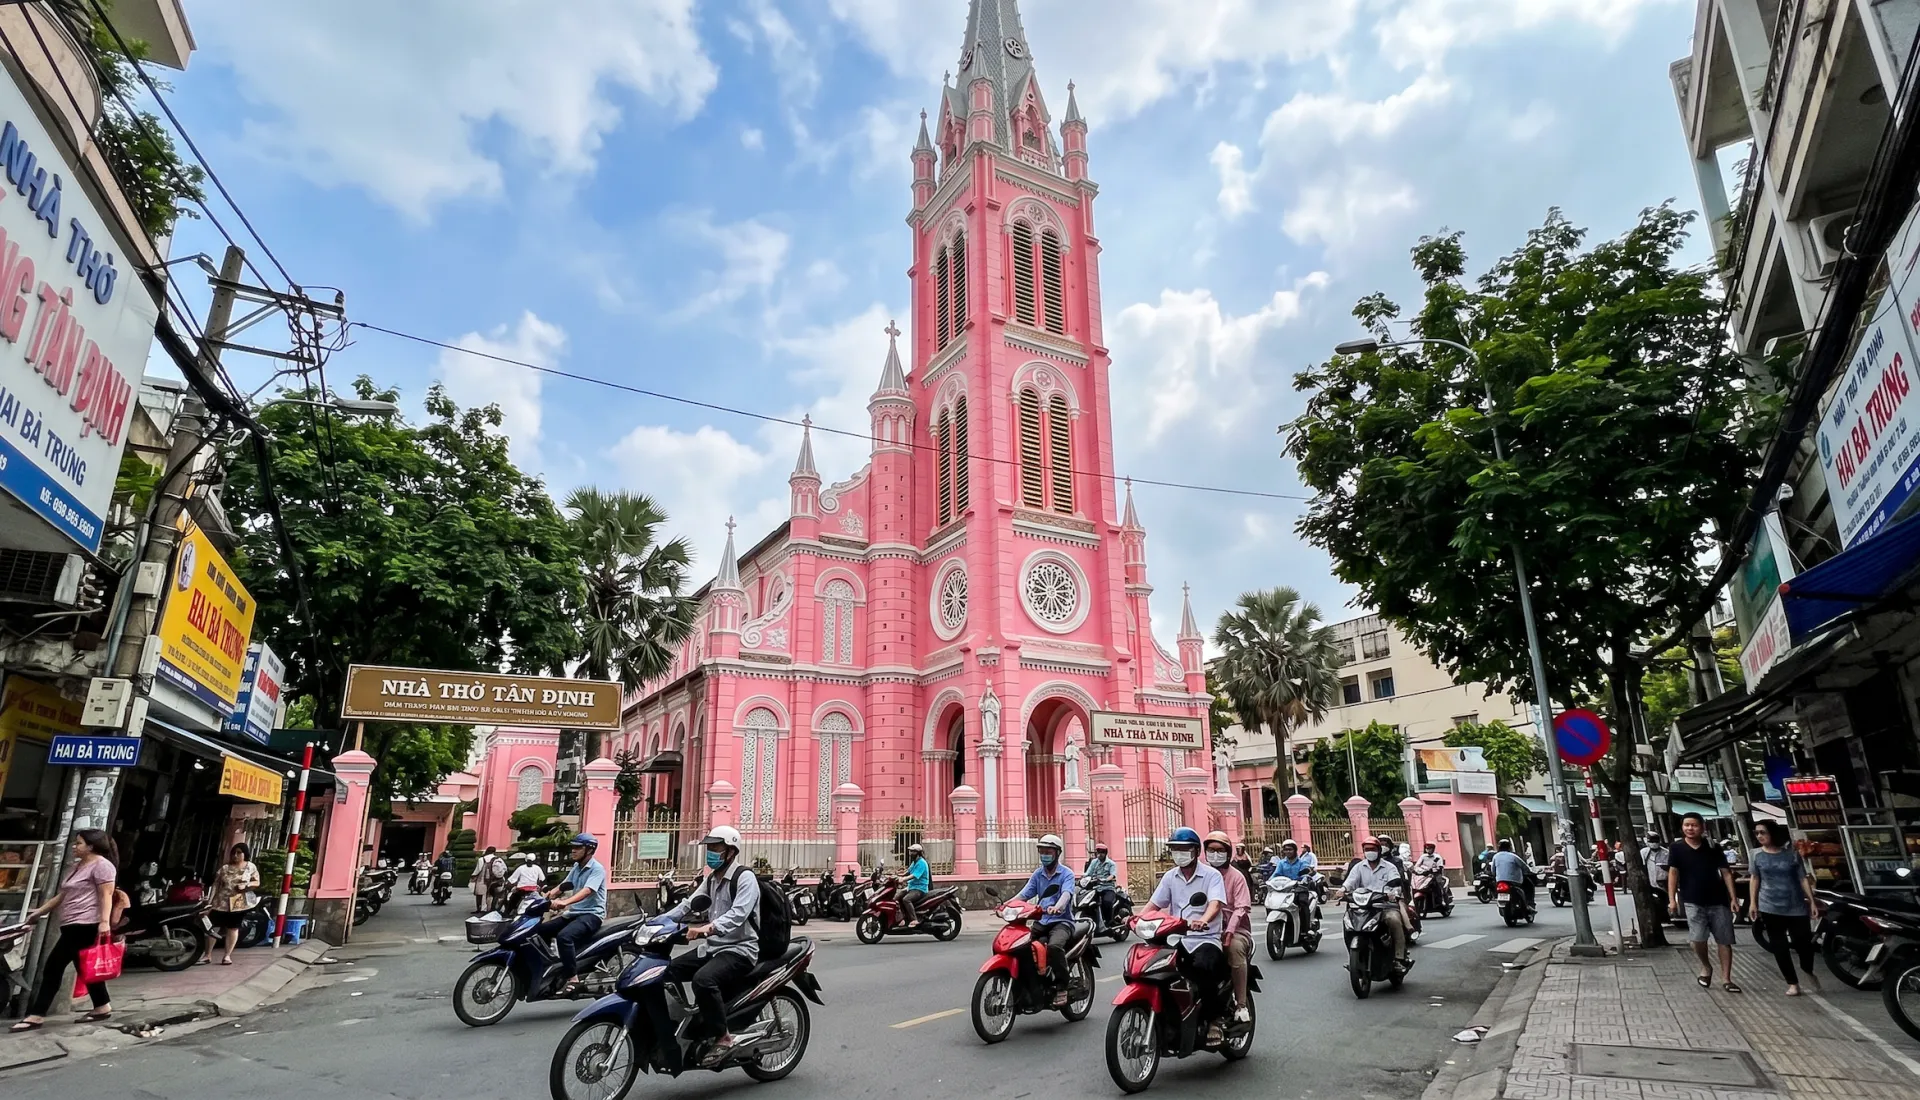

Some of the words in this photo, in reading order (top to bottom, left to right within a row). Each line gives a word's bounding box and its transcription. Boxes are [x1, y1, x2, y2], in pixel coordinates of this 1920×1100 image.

[0, 120, 62, 238] NHÀ
[66, 217, 118, 305] THỜ
[24, 280, 85, 396] TÂN
[69, 338, 131, 446] ĐỊNH
[20, 407, 43, 449] BÀ
[43, 429, 87, 488] TRƯNG
[1835, 440, 1856, 491] HAI
[380, 677, 431, 698] NHÀ
[438, 680, 486, 700] THỜ
[491, 683, 537, 703] TÂN
[541, 688, 595, 709] ĐỊNH
[54, 743, 75, 758] HAI
[76, 740, 93, 759] BÀ
[97, 743, 135, 760] TRƯNG
[1103, 727, 1124, 739] NHÀ
[1149, 729, 1169, 742] TÂN
